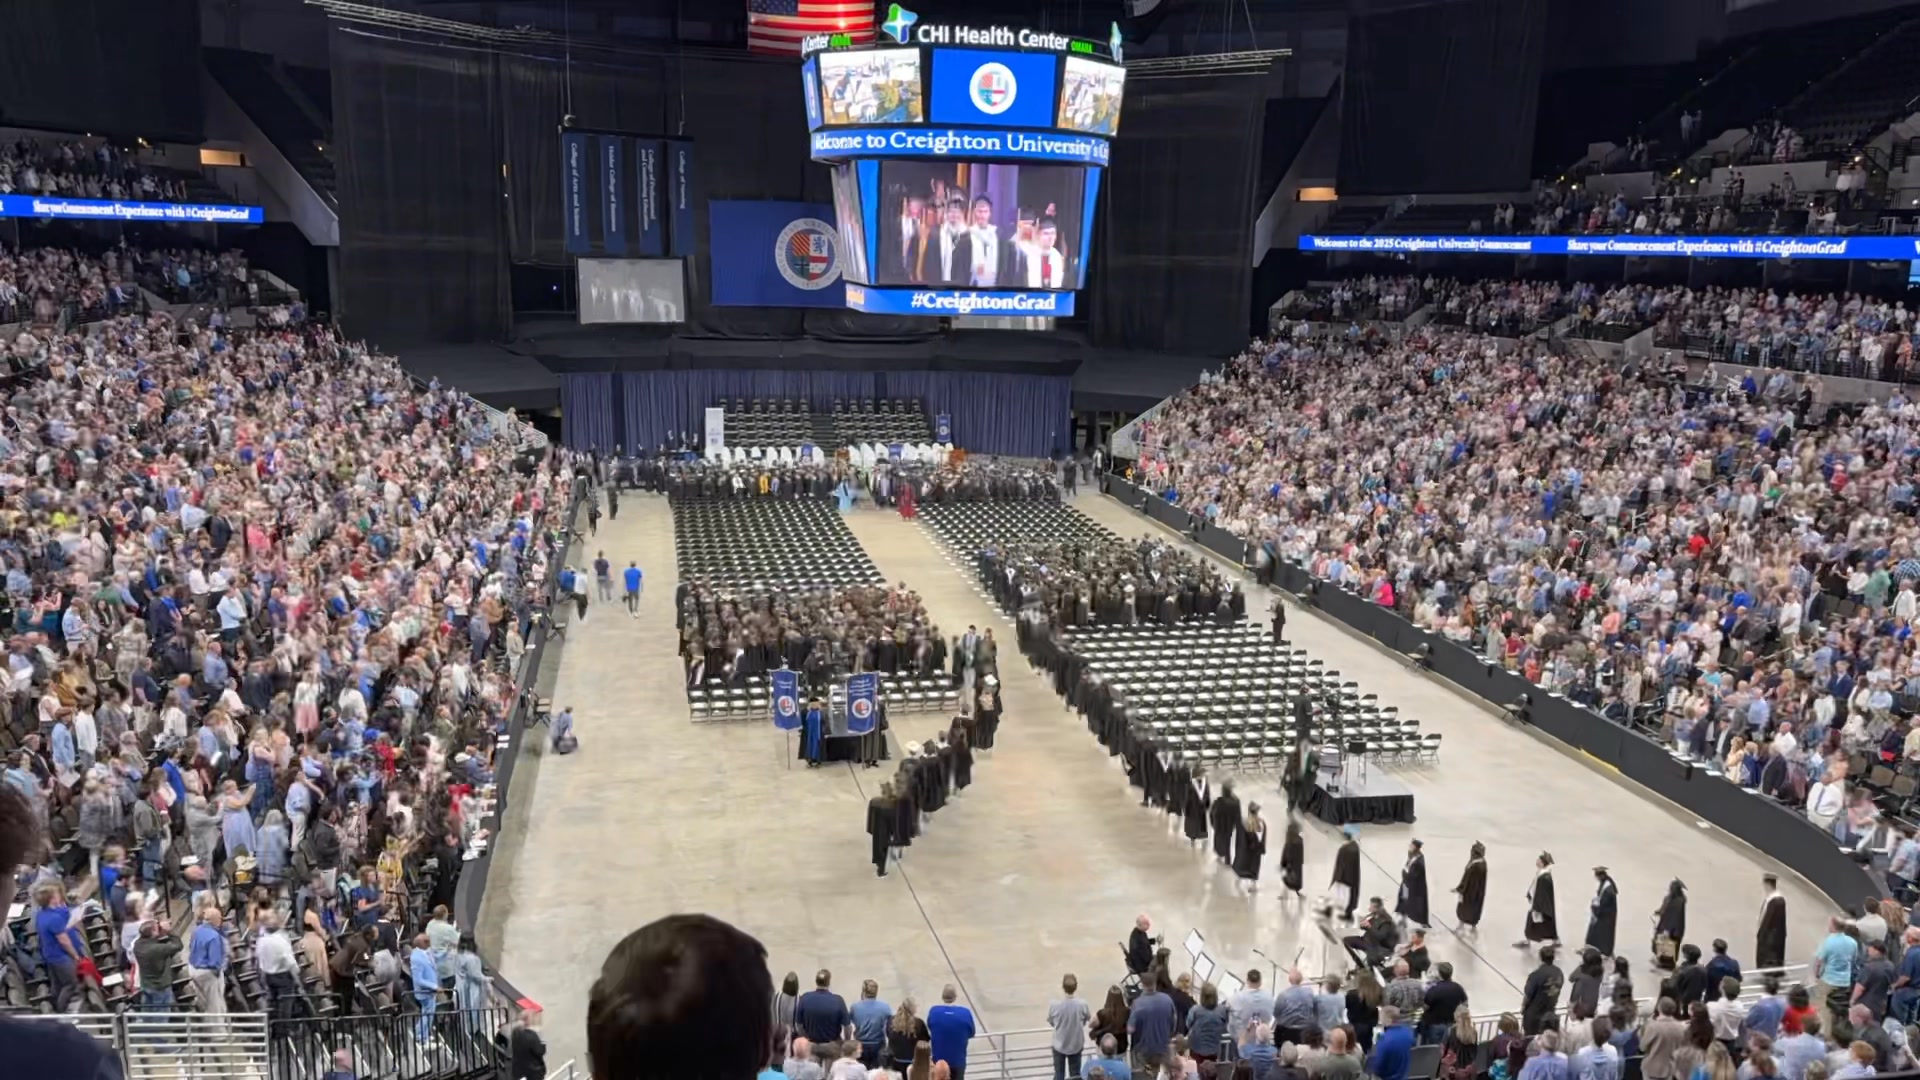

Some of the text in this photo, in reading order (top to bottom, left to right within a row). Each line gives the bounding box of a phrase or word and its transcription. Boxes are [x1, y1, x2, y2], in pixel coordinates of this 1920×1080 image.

[918, 25, 950, 43] CHI
[955, 25, 1014, 46] Health
[1019, 29, 1069, 50] Center
[866, 134, 887, 148] to
[890, 131, 1002, 154] Creighton
[1007, 132, 1098, 160] University's
[115, 204, 164, 219] Experience
[164, 206, 185, 217] with
[1314, 238, 1348, 248] Welcome
[1349, 239, 1358, 248] to
[1359, 239, 1373, 248] the
[1374, 238, 1394, 248] 2025
[1394, 238, 1437, 251] Creighton
[1438, 238, 1479, 251] University
[1567, 239, 1847, 257] Share your Commencement Experience with #CreightonGrad
[911, 292, 1056, 313] #CreightonGrad
